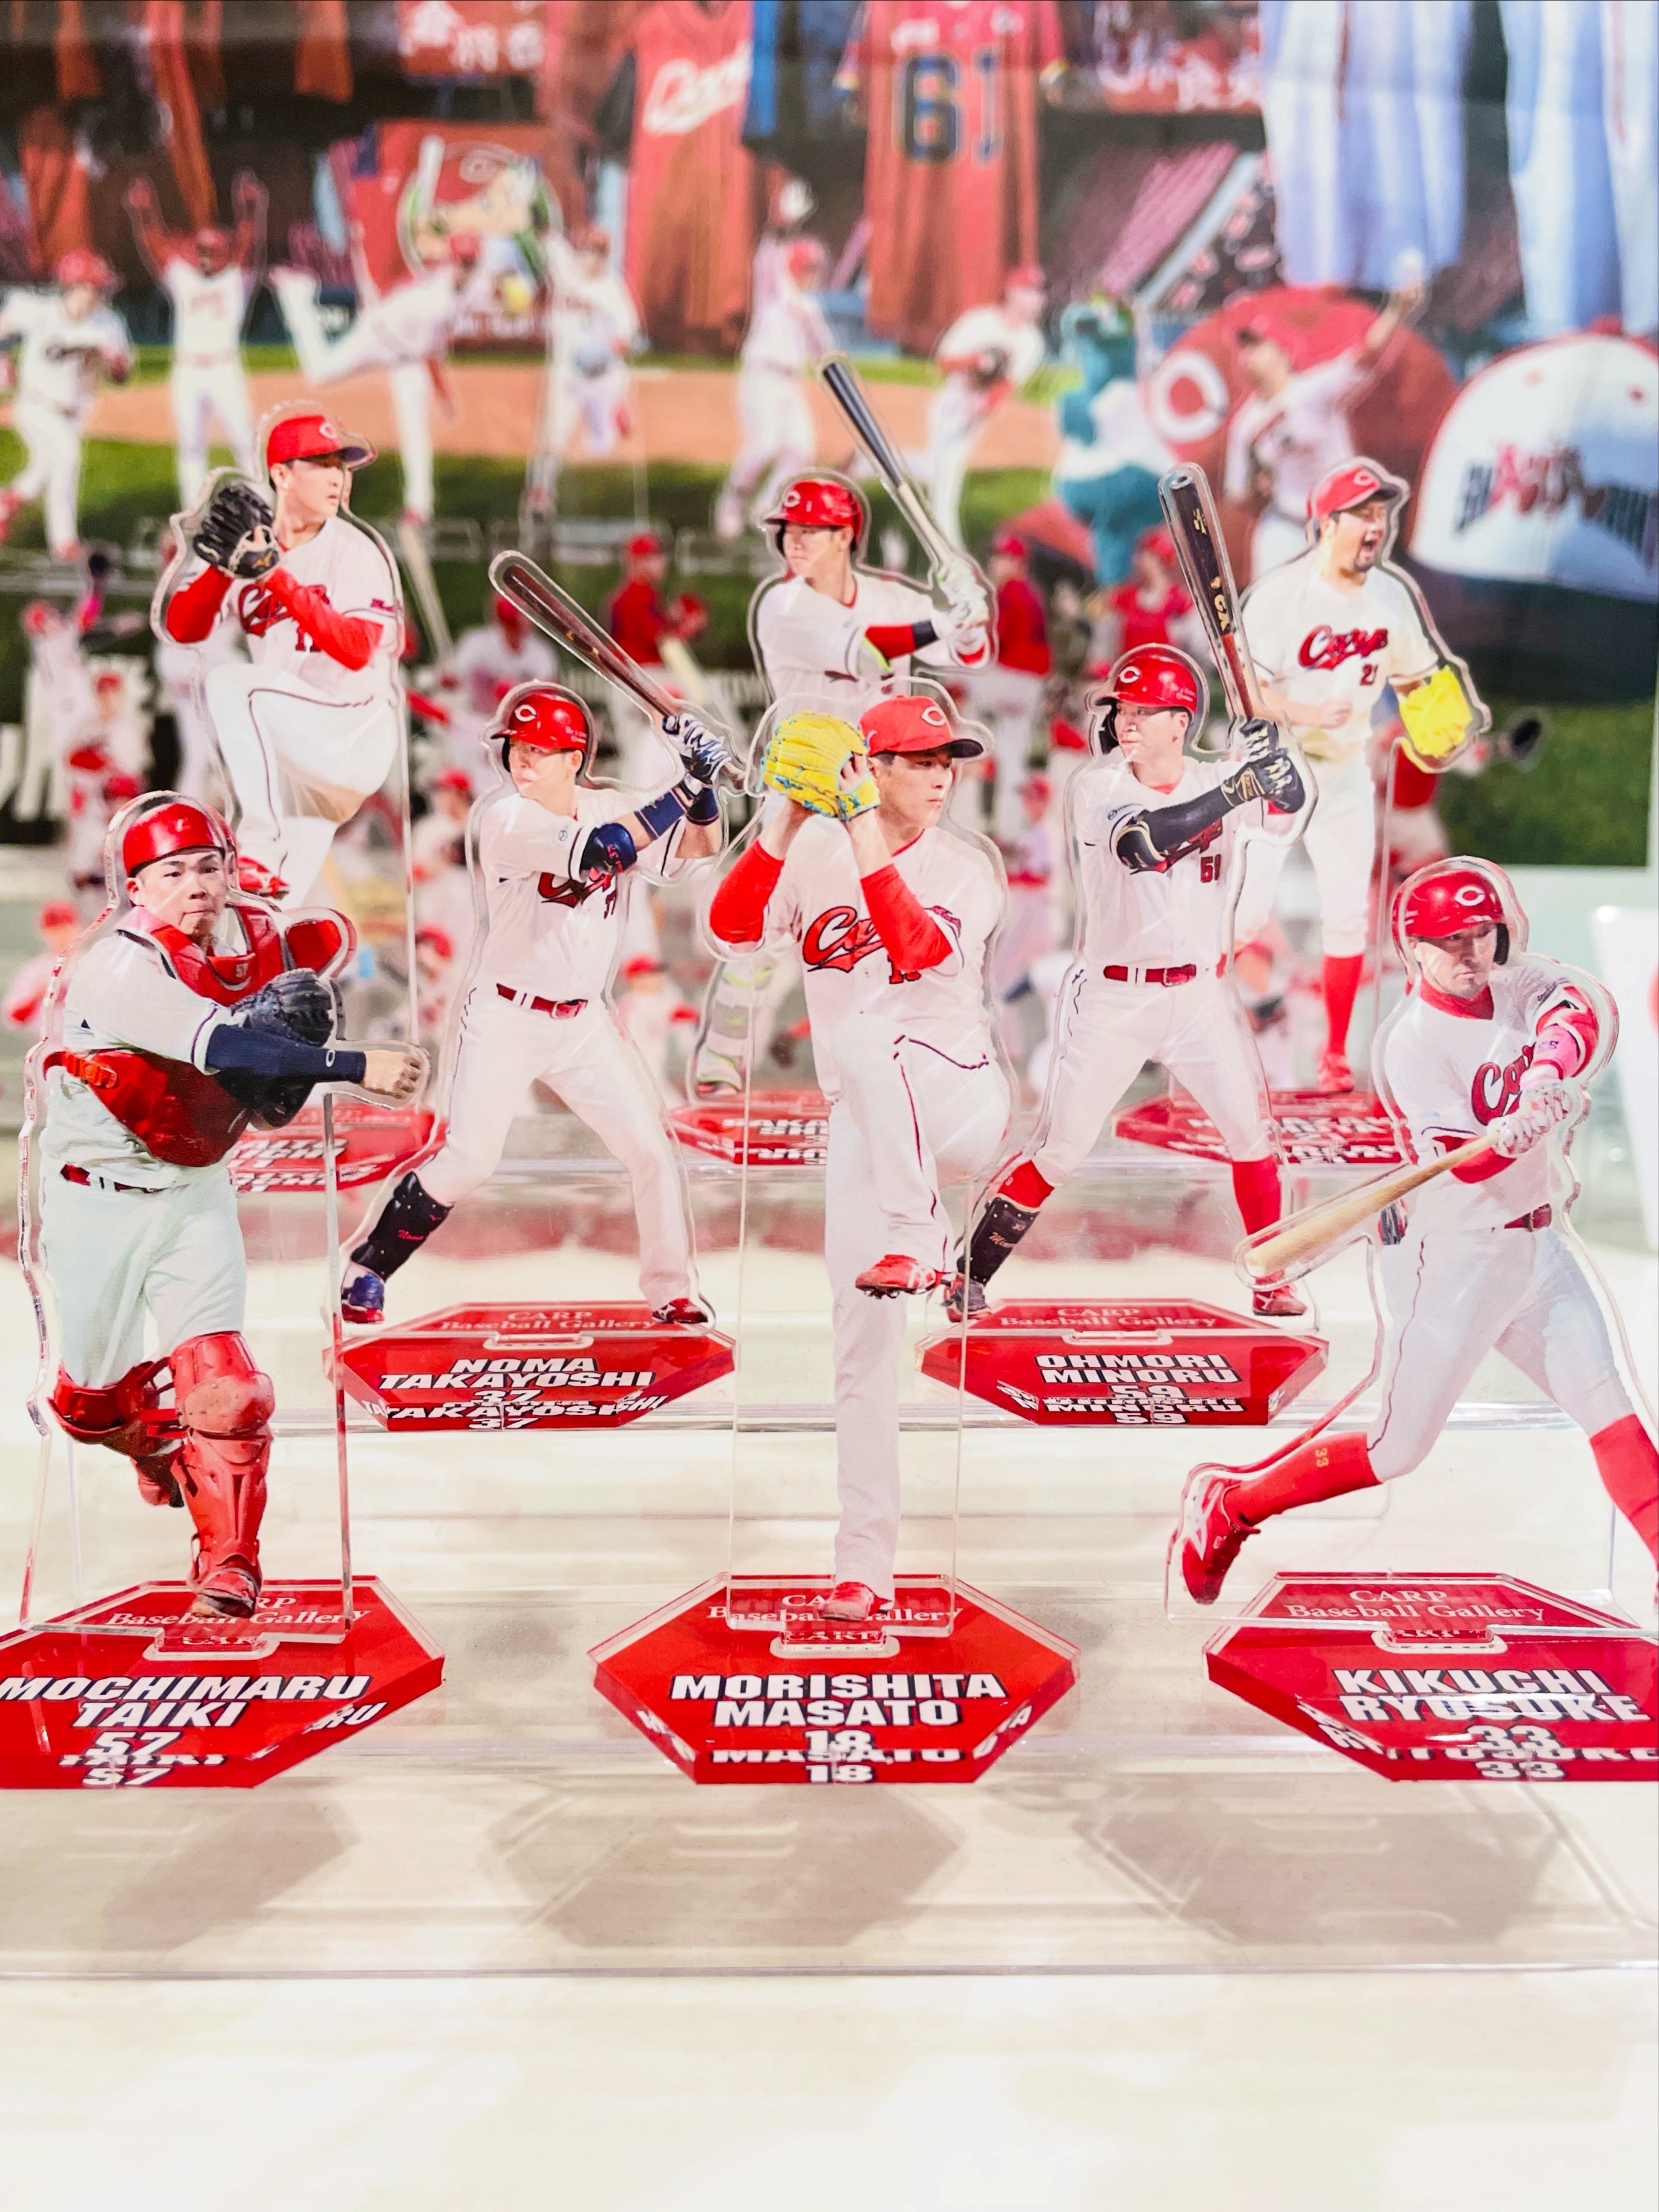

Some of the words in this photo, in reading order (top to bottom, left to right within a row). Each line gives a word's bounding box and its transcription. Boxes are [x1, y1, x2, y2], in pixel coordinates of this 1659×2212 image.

[507, 1311, 593, 1320] CARP
[1057, 1309, 1141, 1317] CARP
[441, 1321, 552, 1331] Baseball
[560, 1320, 654, 1332] Gallery
[1000, 1318, 1111, 1327] Baseball
[1119, 1317, 1218, 1328] Gallery
[450, 1357, 598, 1373] NOMA
[1035, 1354, 1231, 1368] OHMORI
[379, 1372, 656, 1390] TAKAYOSHI
[1042, 1369, 1242, 1384] MINORU
[472, 1389, 543, 1403] 37
[1109, 1384, 1187, 1399] 59
[256, 1597, 297, 1609] RP
[782, 1594, 826, 1606] CA
[1350, 1590, 1448, 1603] CARP
[250, 1610, 373, 1624] Gallery
[1287, 1605, 1420, 1619] Baseball
[1428, 1604, 1545, 1621] Gallery
[0, 1675, 371, 1701] MOCHIMARU
[671, 1674, 1008, 1700] MORISHITA
[1334, 1669, 1613, 1694] KIKUCHI
[72, 1702, 248, 1727] TAIKI
[713, 1701, 962, 1727] MASATO
[1340, 1695, 1652, 1721] RYOSUKE
[85, 1731, 181, 1755] 57
[803, 1730, 874, 1753] 18
[1467, 1724, 1564, 1750] 33
